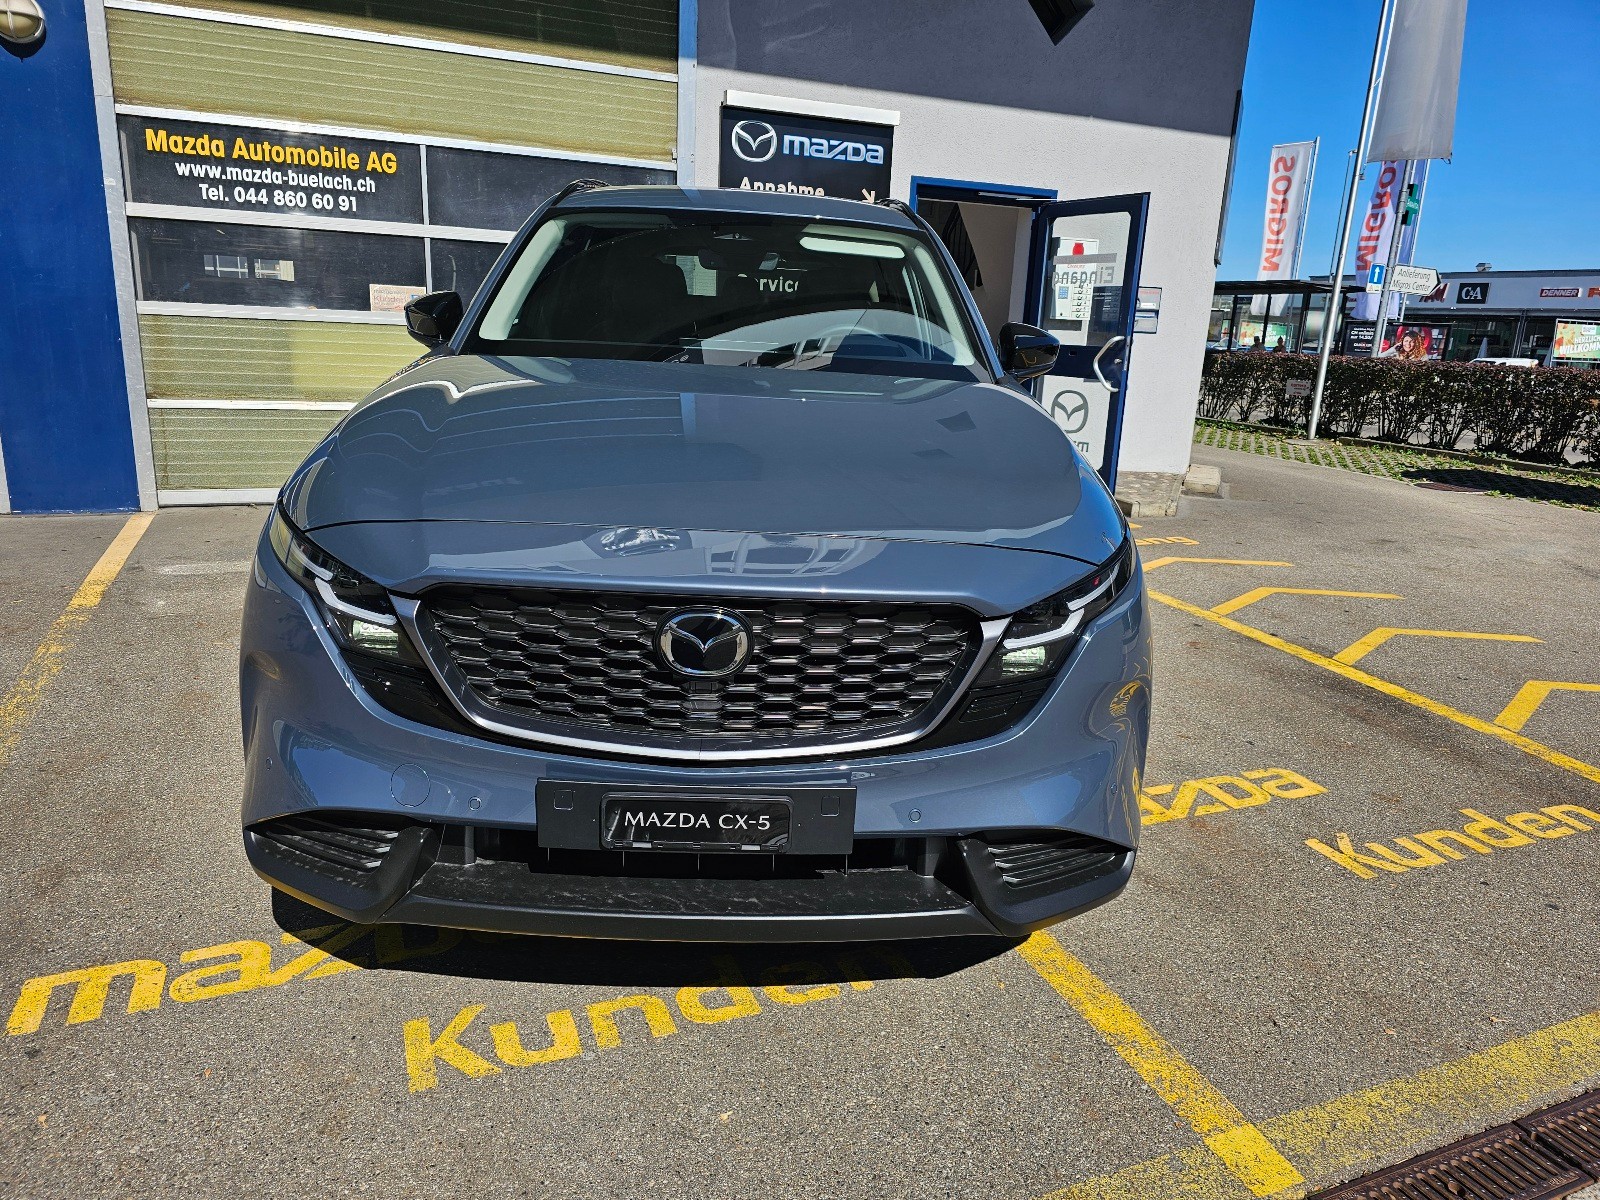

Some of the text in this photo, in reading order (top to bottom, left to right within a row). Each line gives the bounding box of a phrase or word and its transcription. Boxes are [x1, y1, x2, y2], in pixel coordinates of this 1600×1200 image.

[145, 128, 398, 174] Mazda Automobile AG
[782, 134, 884, 165] mazda
[175, 161, 376, 193] www.mazda-buelach.ch
[199, 183, 357, 212] Tel. 044 860 60 91
[1392, 280, 1431, 292] Migros Center
[1397, 268, 1431, 282] Anlieferung
[1461, 286, 1483, 300] C&A
[1541, 289, 1579, 297] DENNER
[624, 811, 771, 830] MAZDA CX-5
[1305, 804, 1600, 880] Kunden
